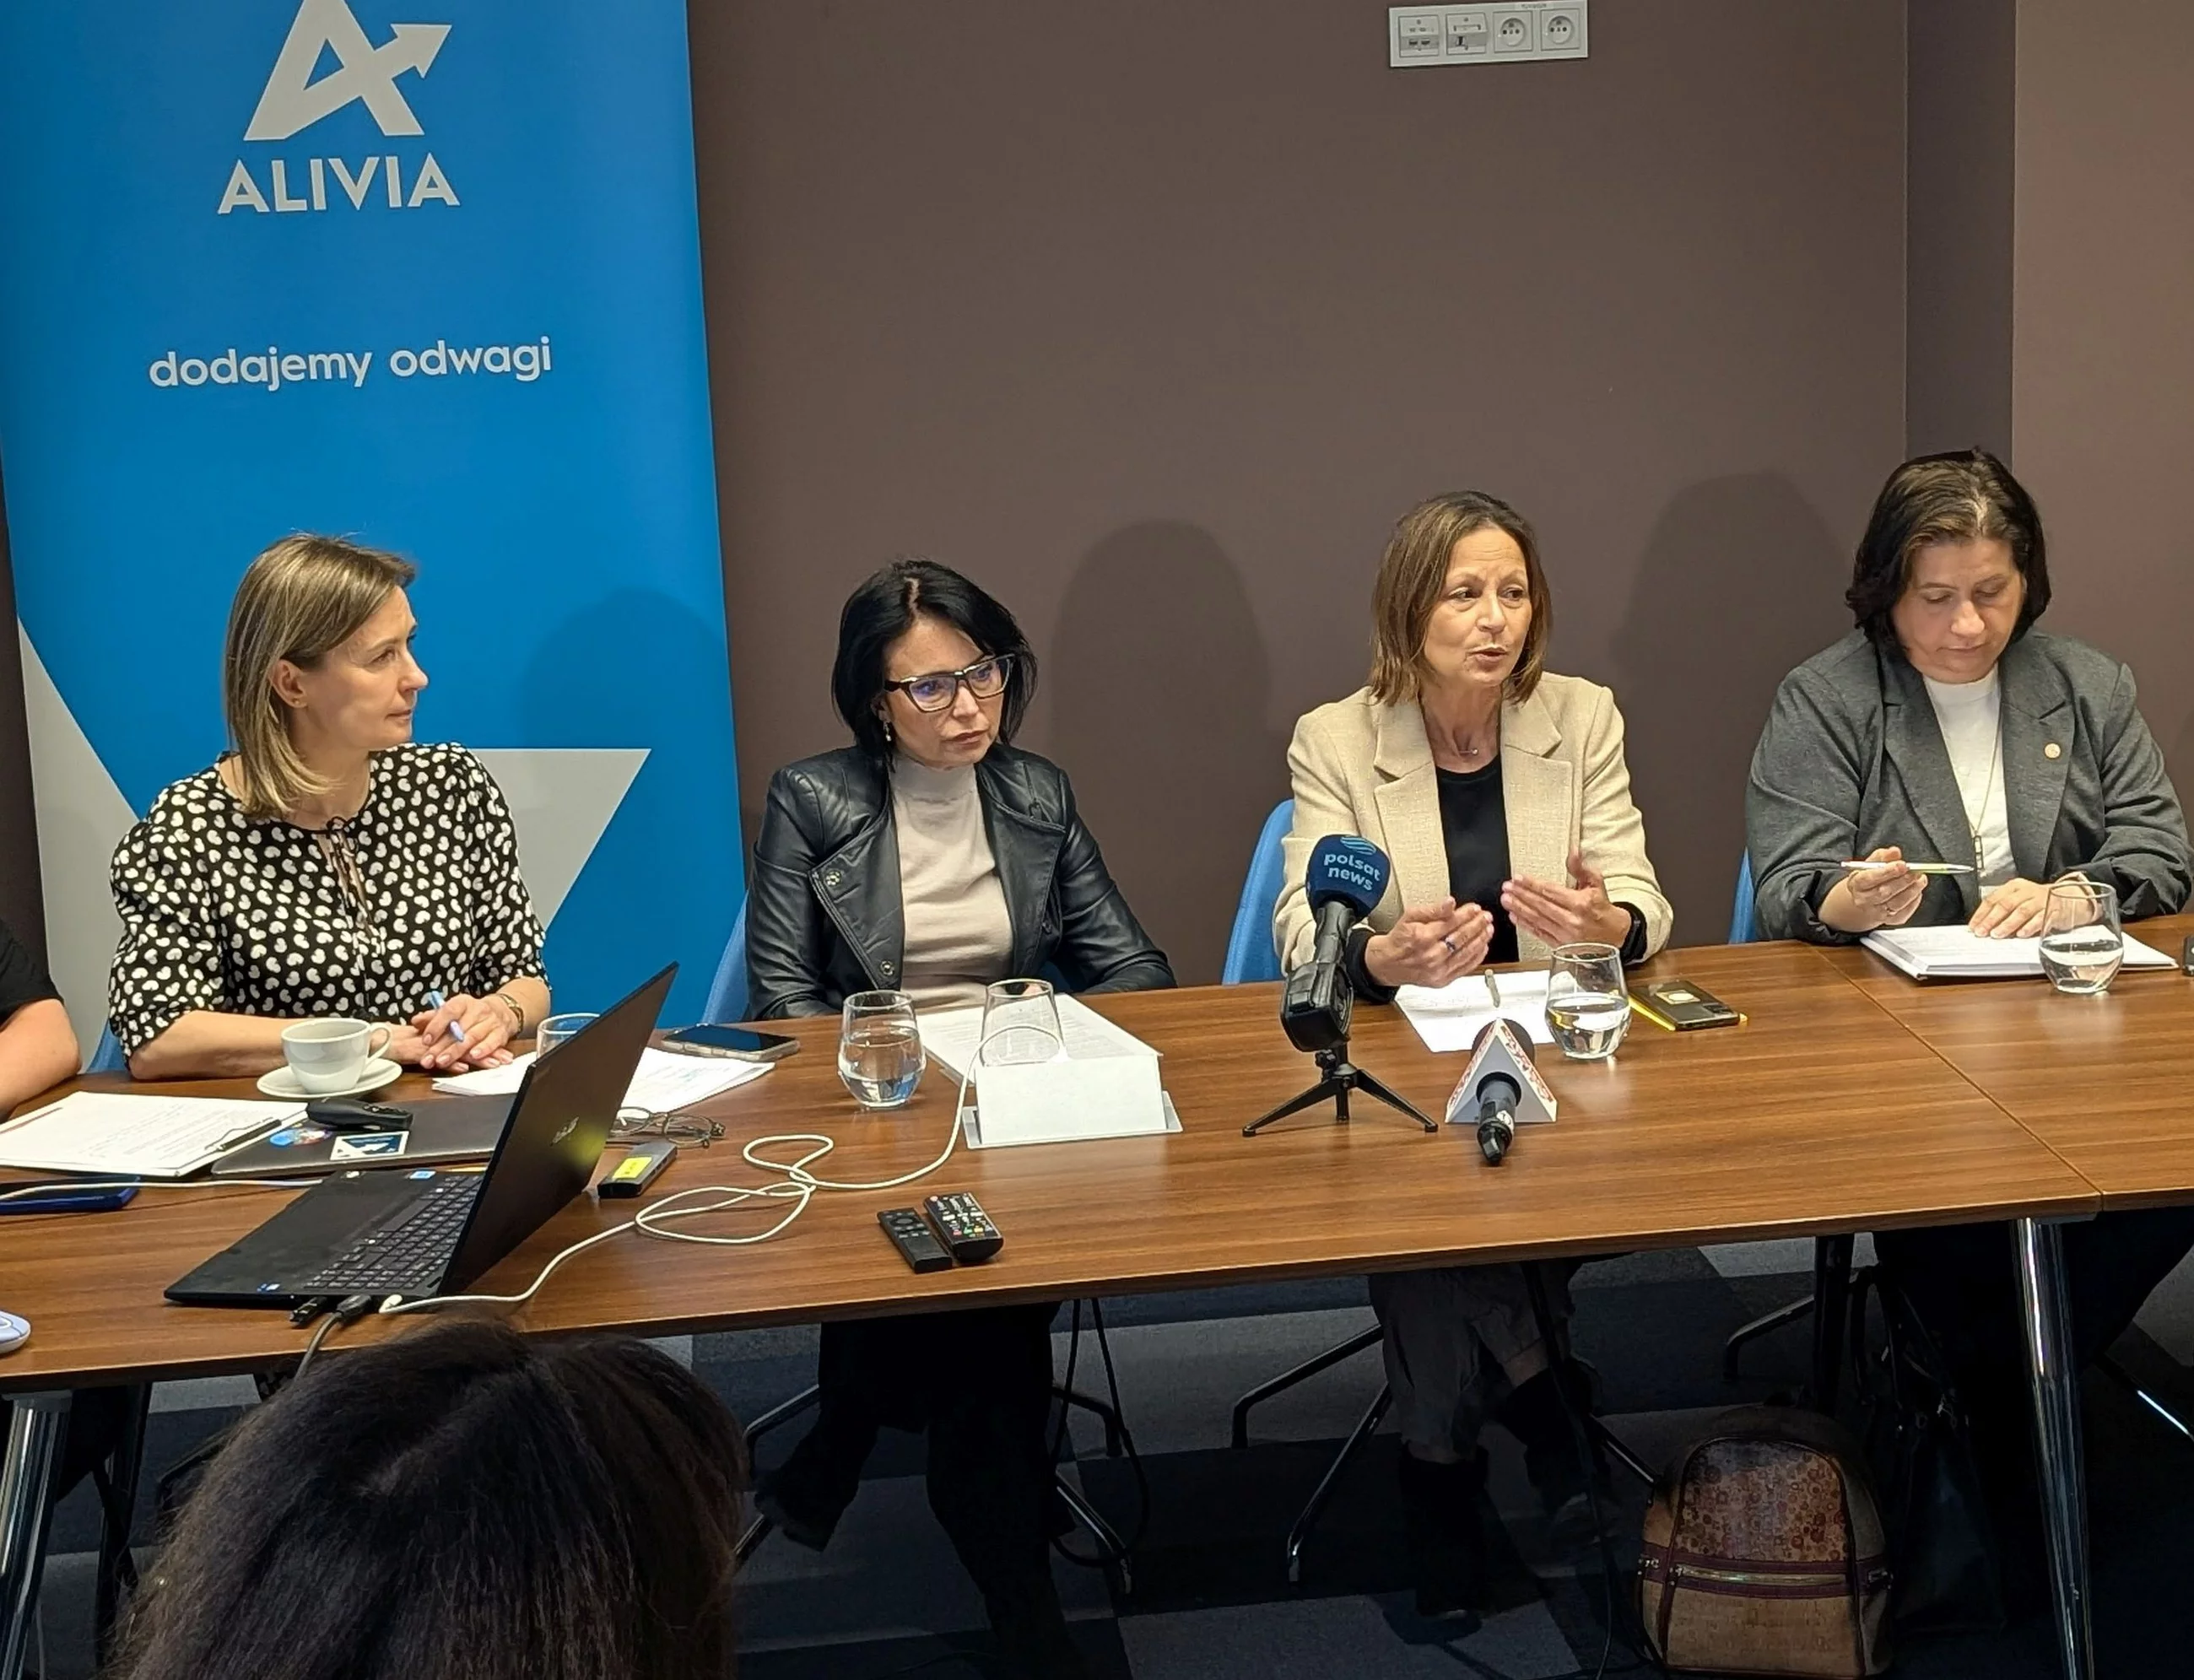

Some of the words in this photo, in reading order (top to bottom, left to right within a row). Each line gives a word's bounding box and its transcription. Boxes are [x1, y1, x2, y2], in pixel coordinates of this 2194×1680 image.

[218, 154, 460, 213] ALIVIA
[149, 347, 372, 391] dodajemy
[390, 337, 551, 381] odwagi
[1323, 854, 1381, 881] polsat
[1327, 867, 1373, 891] news
